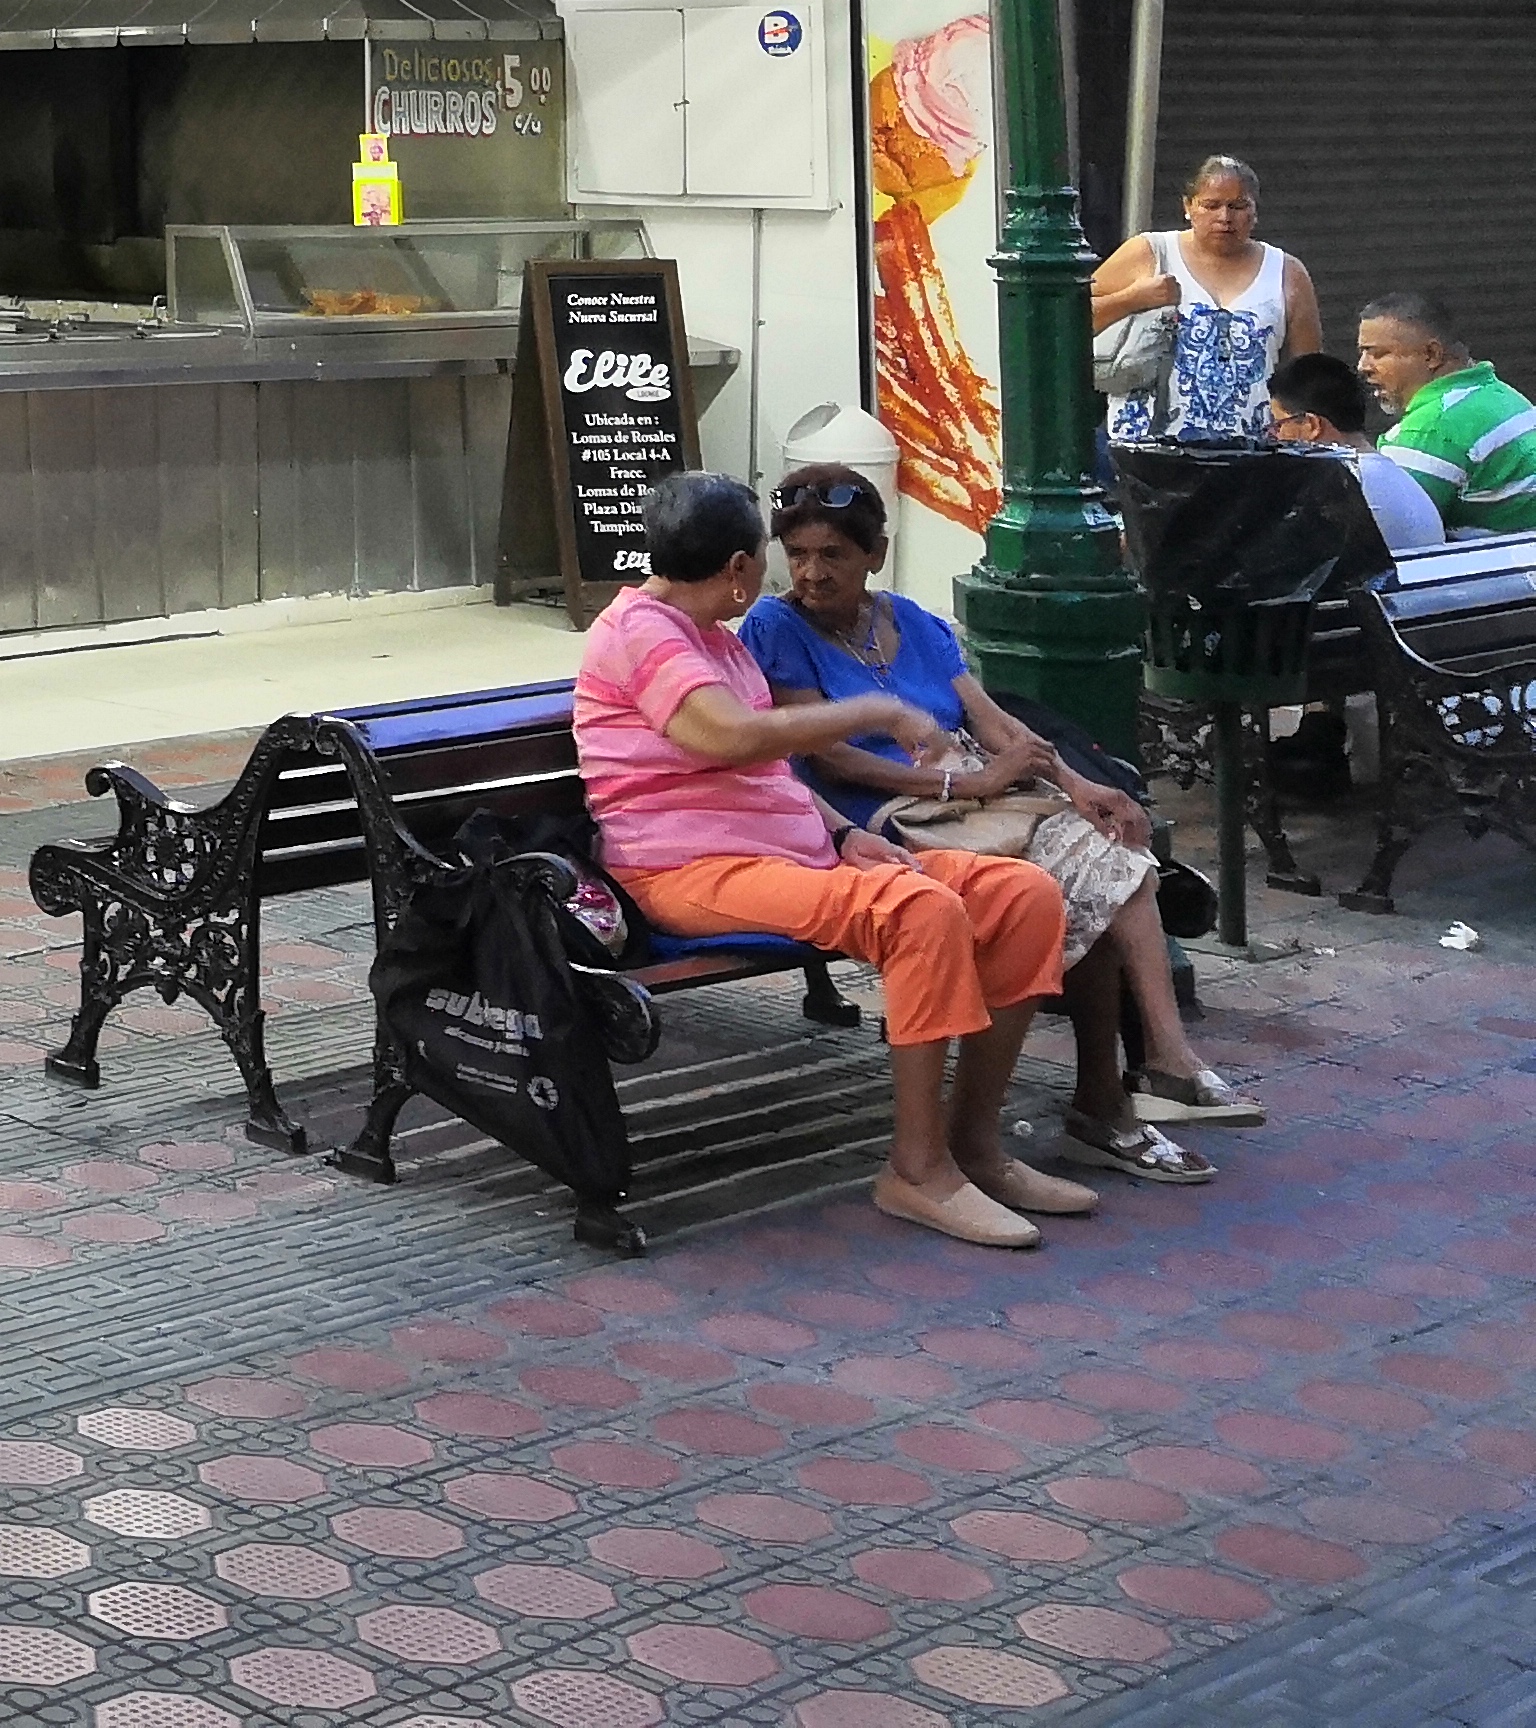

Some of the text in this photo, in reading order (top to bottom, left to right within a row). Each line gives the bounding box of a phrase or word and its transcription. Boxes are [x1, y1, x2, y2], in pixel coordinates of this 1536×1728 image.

[383, 48, 492, 86] Deliciosos
[373, 85, 497, 138] CHURROS
[514, 112, 542, 136] c/u
[567, 292, 656, 306] Conoce Nuestra
[568, 309, 658, 324] Nueva Sucursal
[563, 348, 671, 393] Elite
[584, 413, 636, 427] Ubicada
[636, 416, 653, 426] en
[571, 429, 676, 444] Lomas de Rosales
[612, 447, 648, 461] Local
[609, 466, 647, 479] Fracc.
[577, 484, 619, 498] Lomas
[620, 483, 635, 497] de
[583, 501, 618, 516] Plaza
